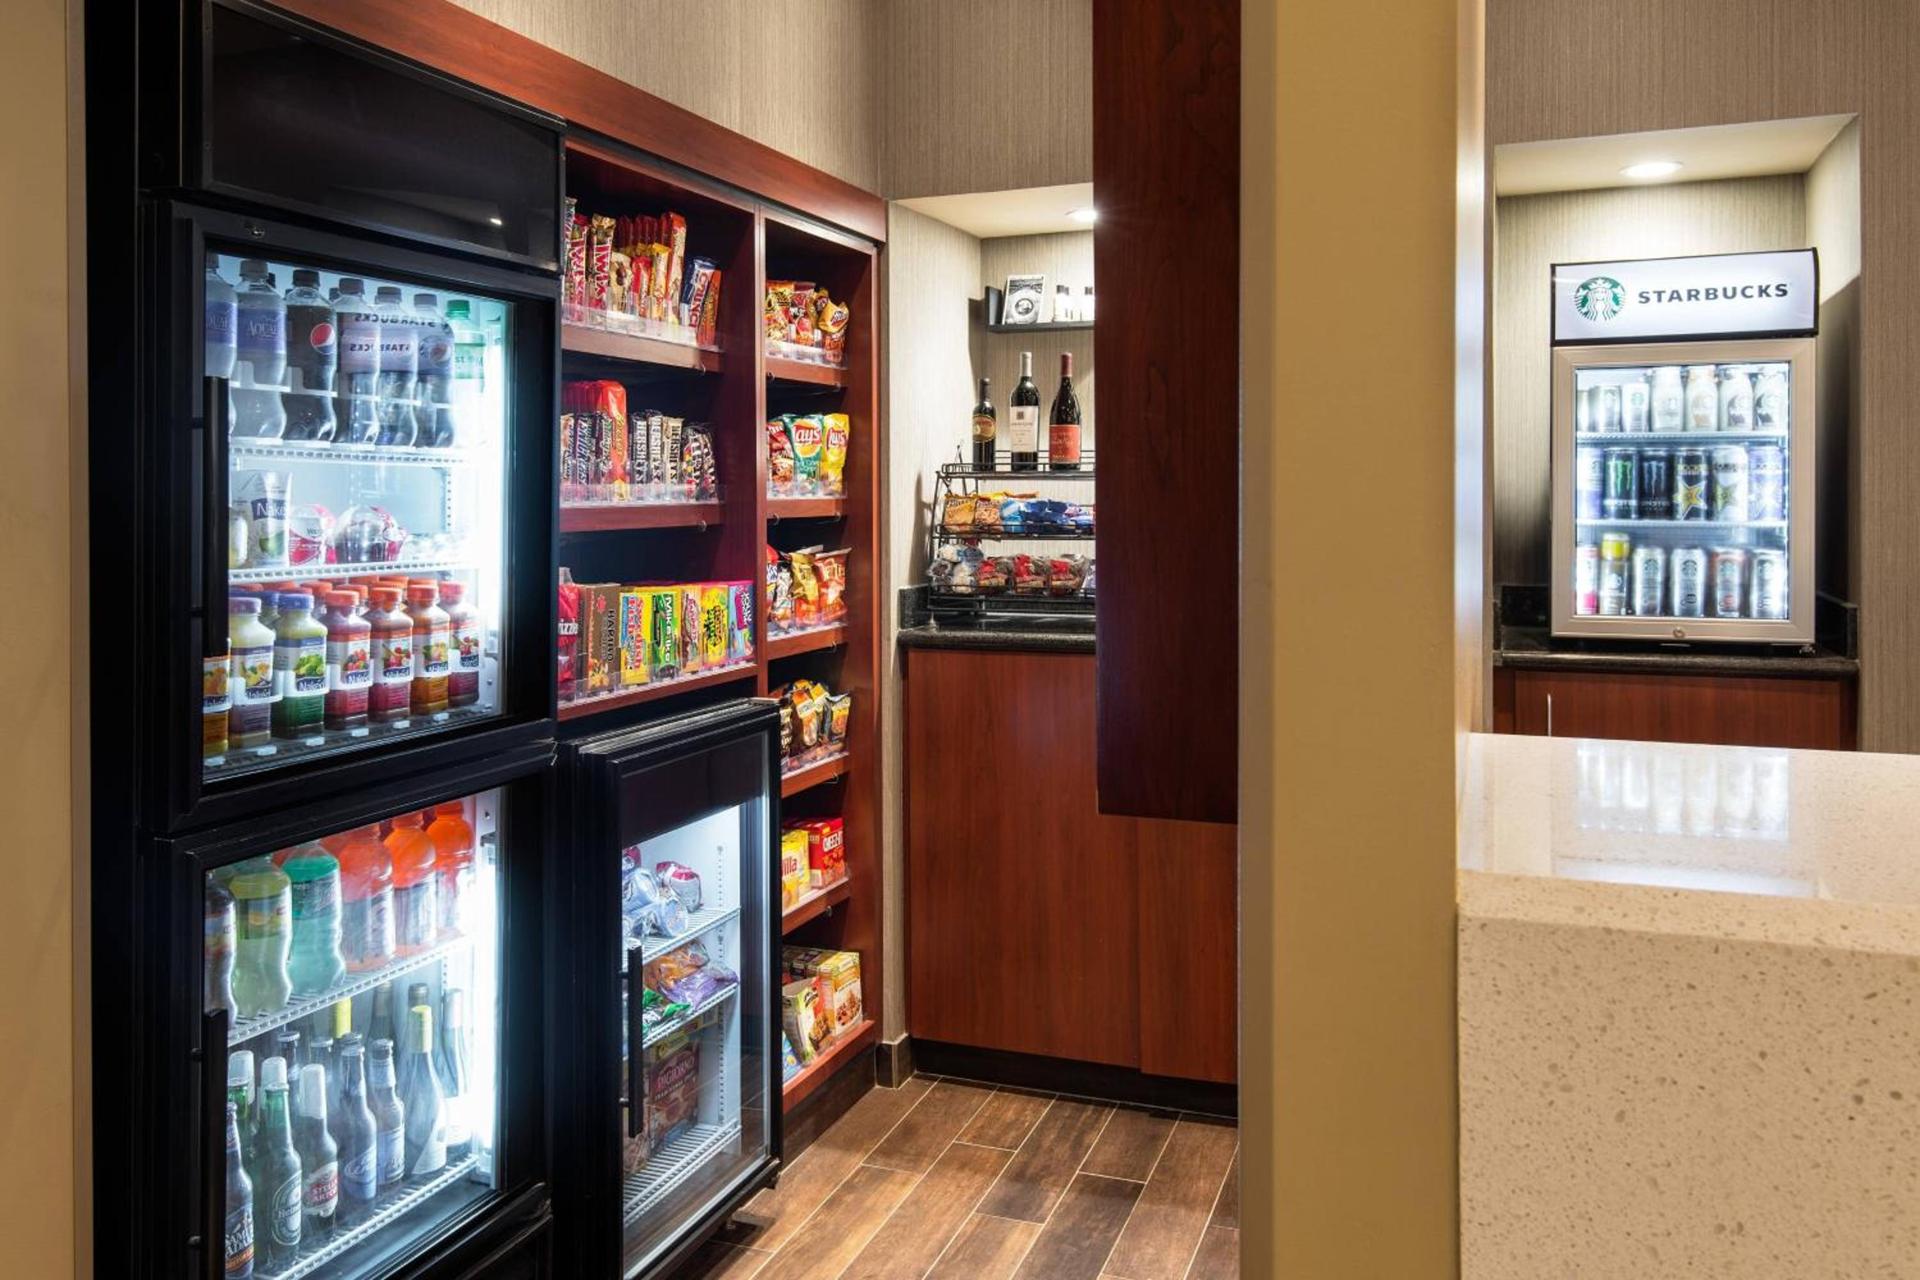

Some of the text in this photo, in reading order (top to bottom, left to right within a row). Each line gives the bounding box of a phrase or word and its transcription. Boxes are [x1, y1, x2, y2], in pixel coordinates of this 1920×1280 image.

[1637, 282, 1789, 305] STARBUCKS
[635, 420, 647, 482] HERSHEY'S
[651, 416, 662, 476] HERSHEY'S
[669, 425, 680, 480] HERSHEY'S
[606, 609, 616, 663] HARIBO
[626, 597, 637, 635] Fish
[633, 598, 645, 670] Swedish
[665, 596, 674, 636] Mike
